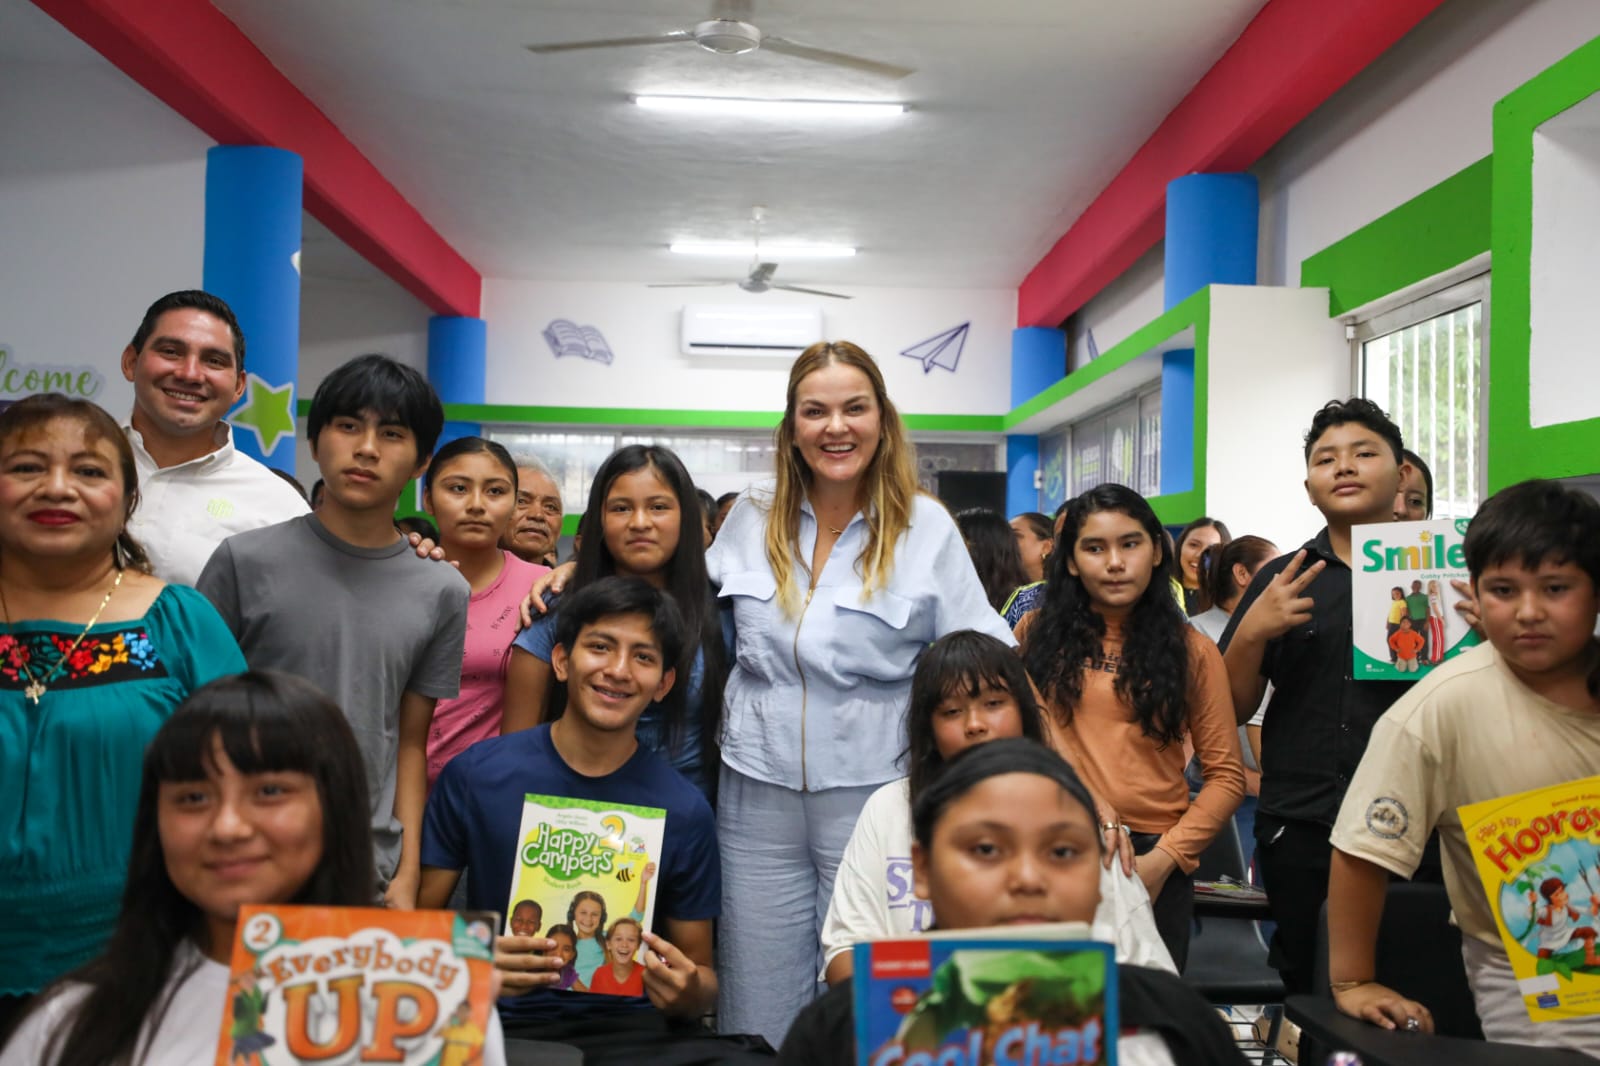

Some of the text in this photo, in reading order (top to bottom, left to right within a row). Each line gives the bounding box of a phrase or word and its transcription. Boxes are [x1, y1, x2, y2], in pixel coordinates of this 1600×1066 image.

[1362, 530, 1467, 572] Smile
[538, 822, 596, 855] Happy
[599, 814, 626, 853] 2
[522, 843, 614, 876] Campers
[253, 921, 271, 943] 2
[267, 939, 459, 989] Everybody
[282, 974, 439, 1063] UP
[994, 1016, 1100, 1066] Chat
